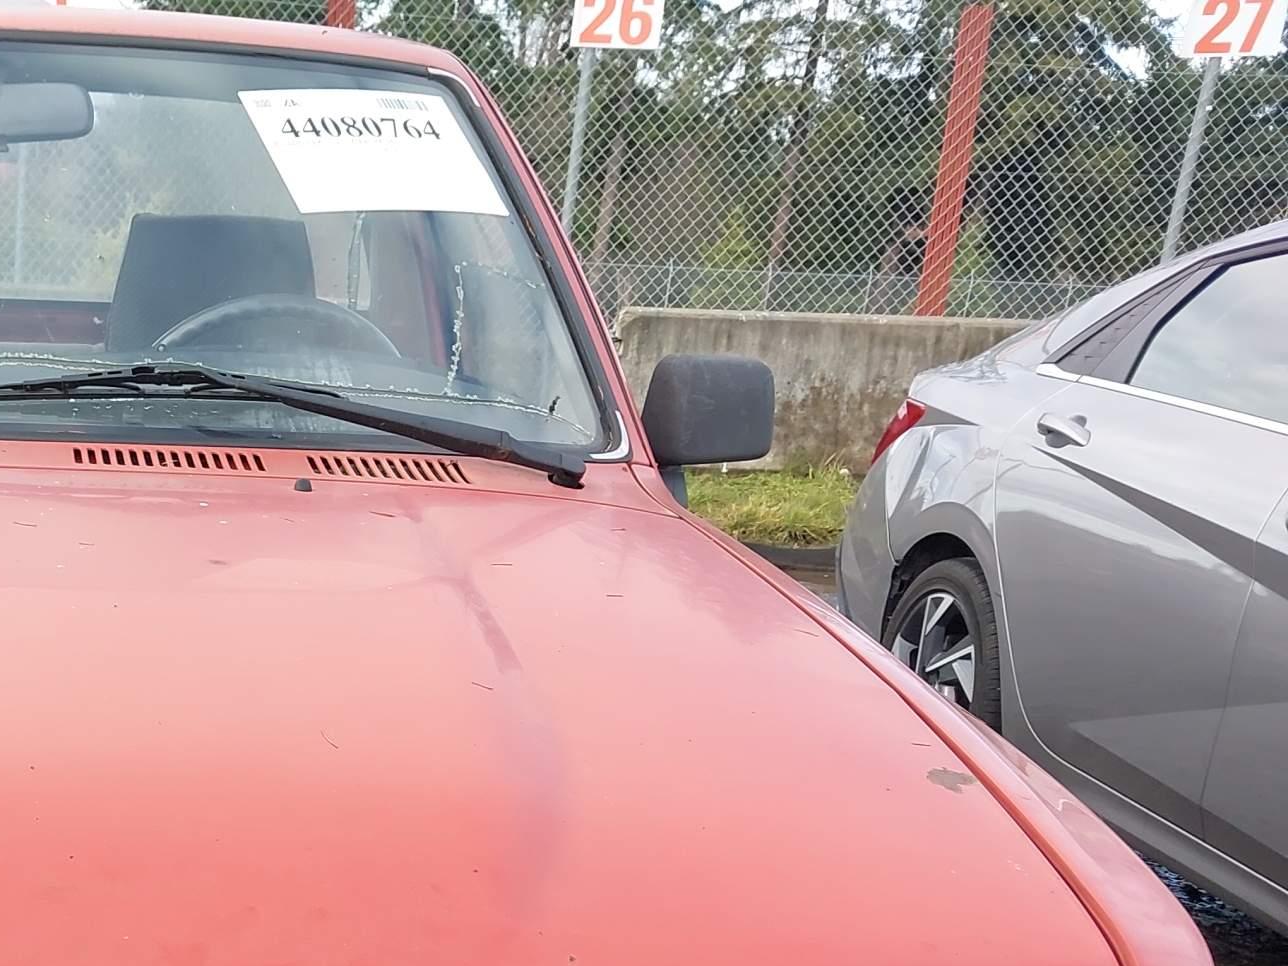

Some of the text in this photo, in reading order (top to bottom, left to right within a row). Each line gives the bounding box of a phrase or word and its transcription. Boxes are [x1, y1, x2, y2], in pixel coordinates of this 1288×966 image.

[579, 0, 654, 45] 26
[1193, 0, 1274, 53] 27
[281, 116, 441, 140] 44080764
